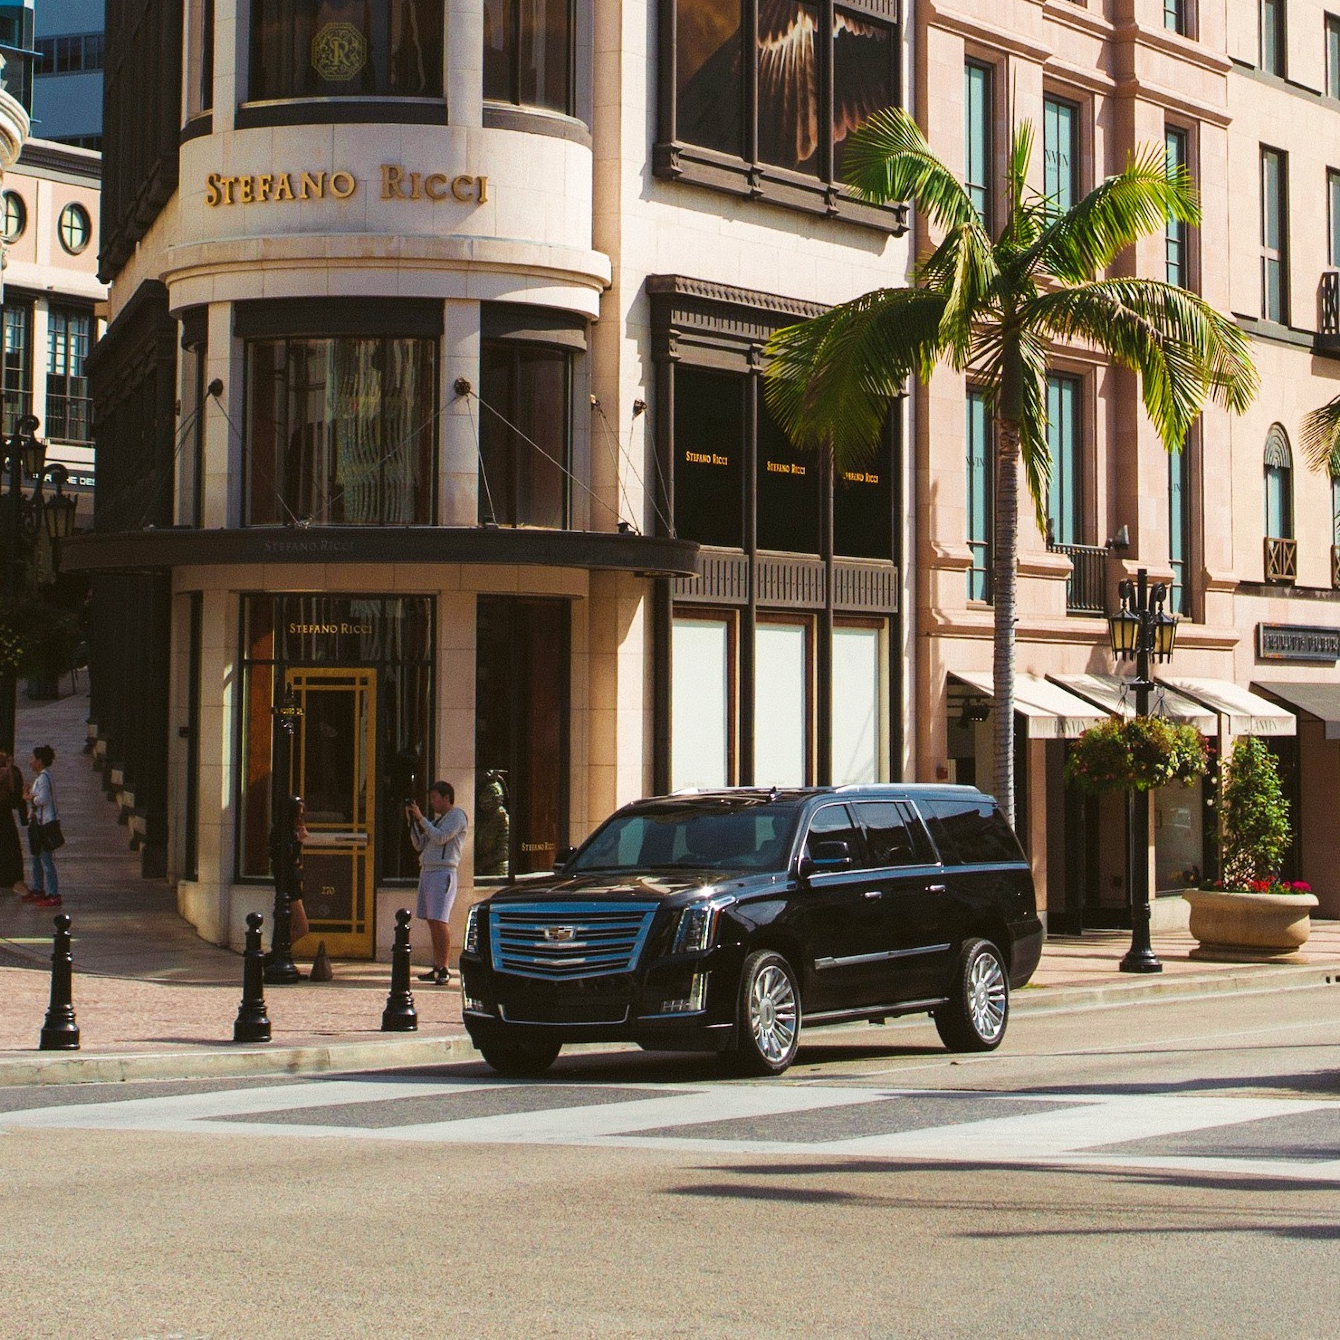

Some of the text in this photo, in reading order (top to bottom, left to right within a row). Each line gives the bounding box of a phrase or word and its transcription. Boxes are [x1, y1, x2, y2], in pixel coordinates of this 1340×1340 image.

[206, 163, 489, 206] STEFANO RICCI
[685, 451, 728, 466] STEFANO RICCI
[289, 623, 373, 634] STEFANO RICCI
